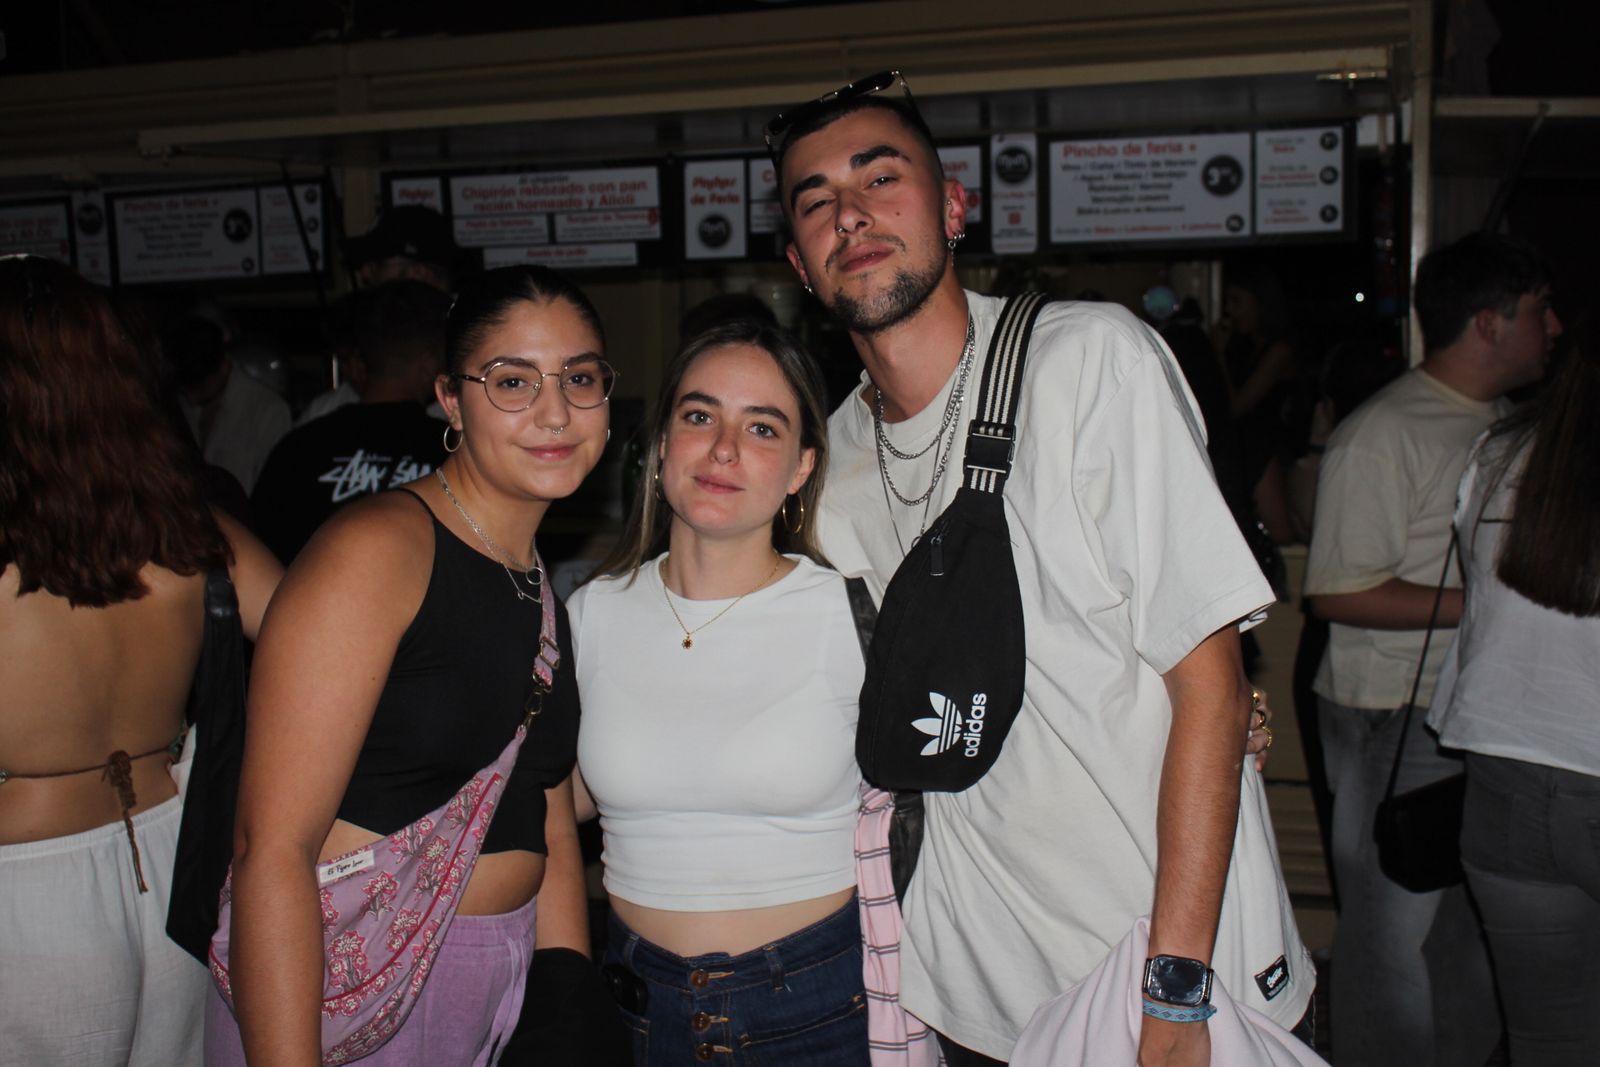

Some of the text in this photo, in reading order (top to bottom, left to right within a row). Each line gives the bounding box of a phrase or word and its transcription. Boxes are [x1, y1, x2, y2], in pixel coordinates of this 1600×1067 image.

[1062, 142, 1118, 157] Pincho
[1122, 141, 1142, 155] de
[1146, 140, 1183, 154] feria
[522, 181, 586, 195] rebozado
[588, 182, 615, 192] con
[620, 181, 647, 193] pan
[516, 198, 583, 211] horneado
[963, 693, 987, 757] adidas
